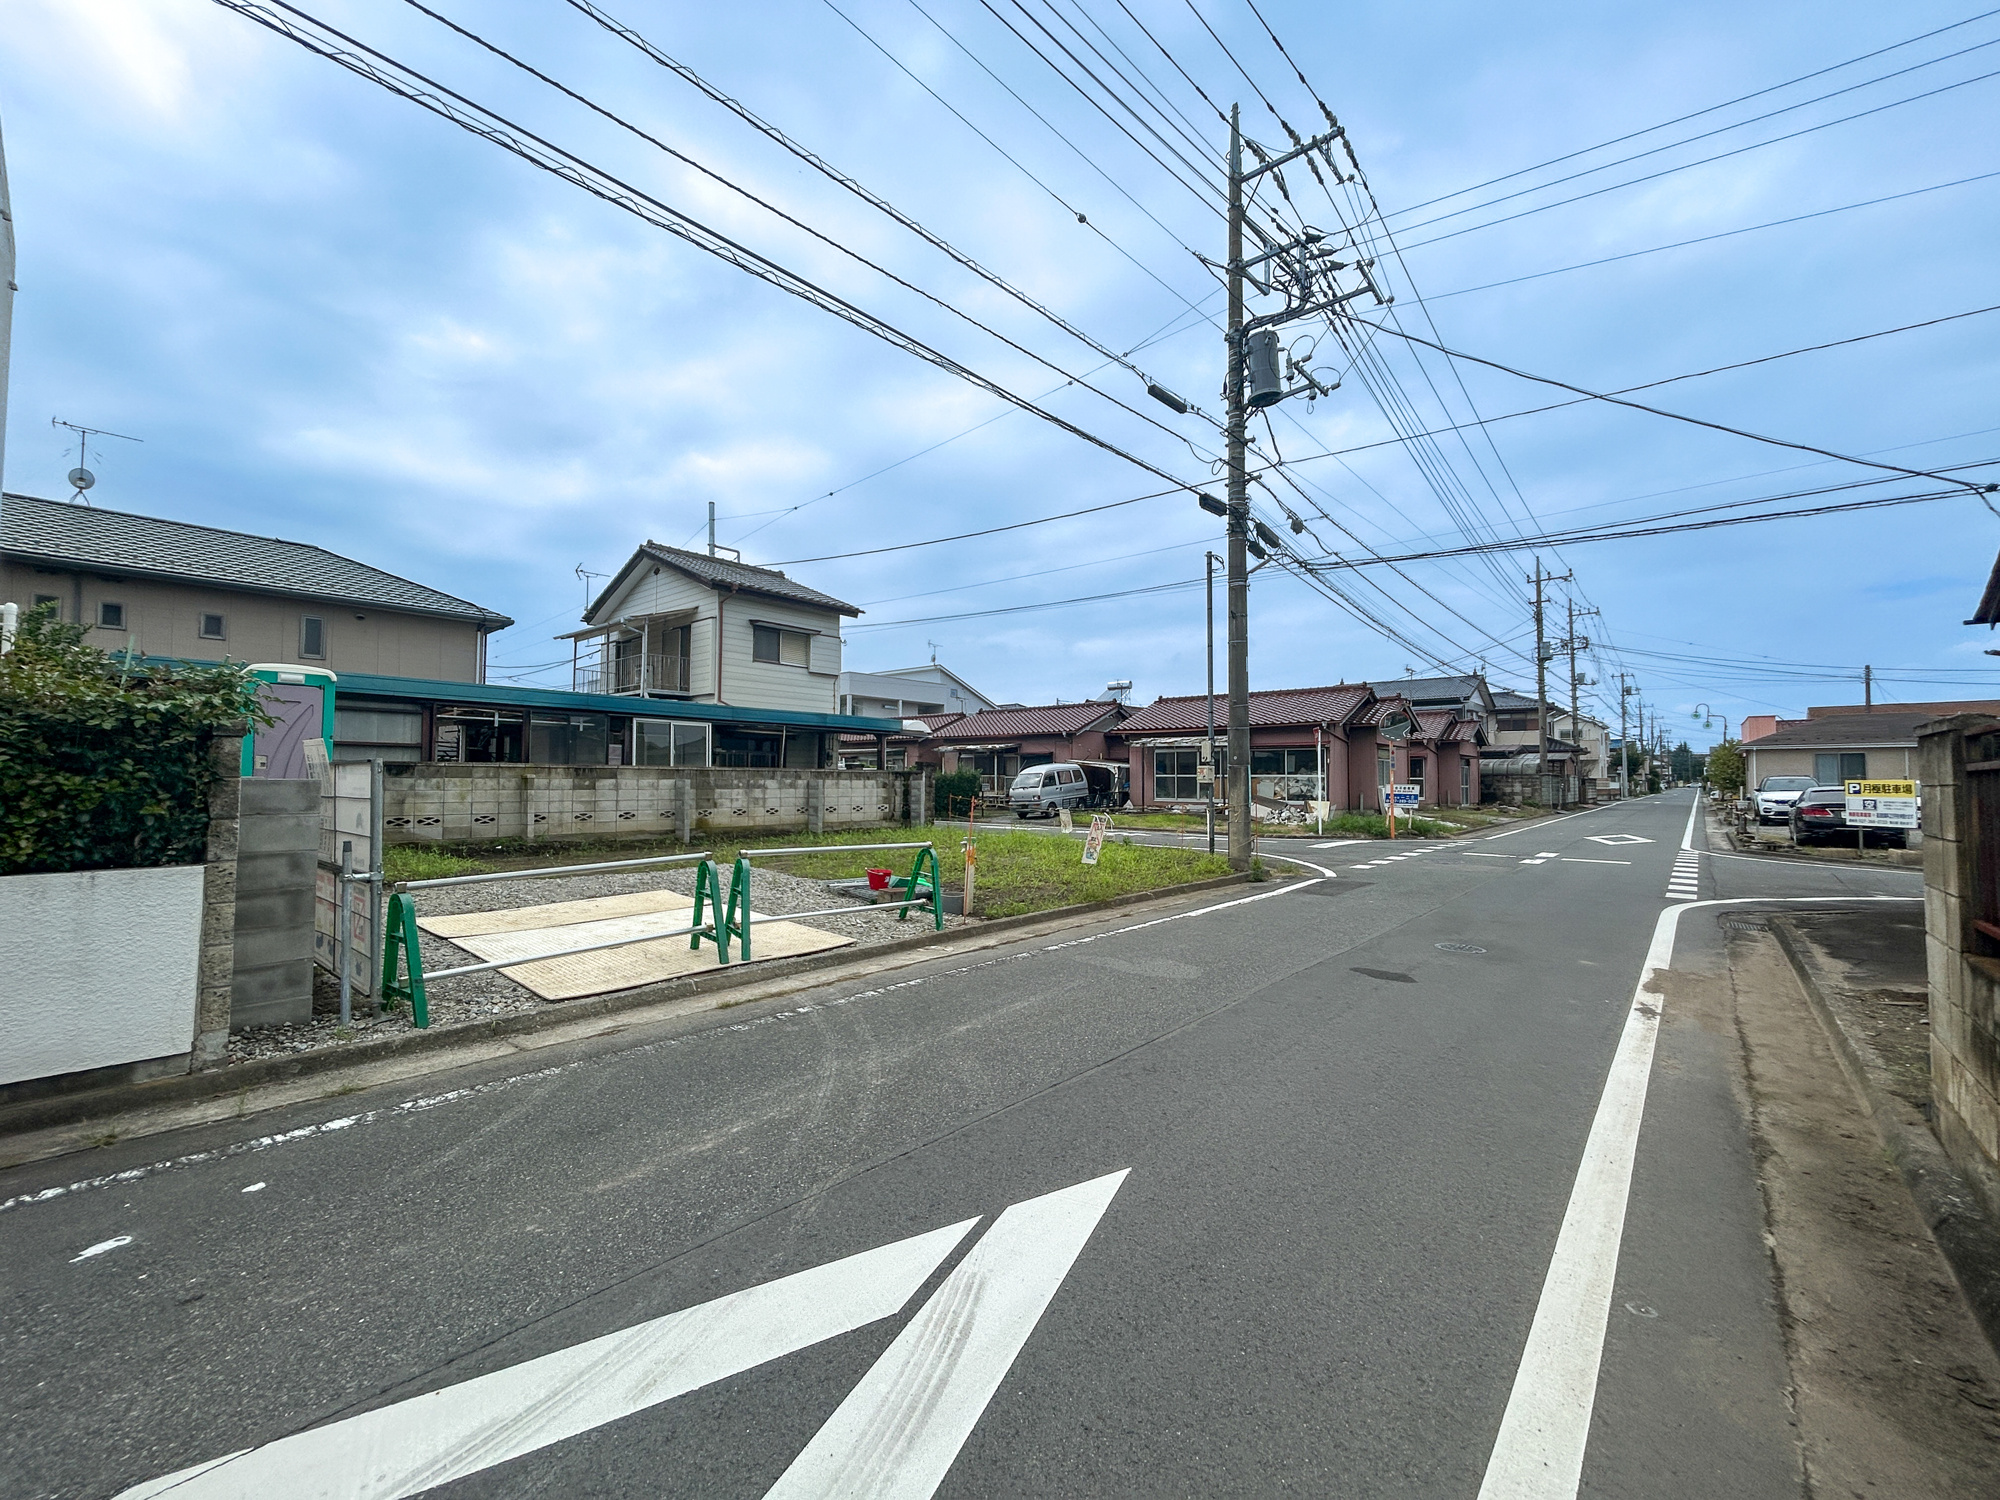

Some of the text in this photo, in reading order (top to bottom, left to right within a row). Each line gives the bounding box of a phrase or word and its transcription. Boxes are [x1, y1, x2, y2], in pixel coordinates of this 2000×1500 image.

[1848, 784, 1860, 794] P
[1863, 784, 1912, 794] 月極駐車場
